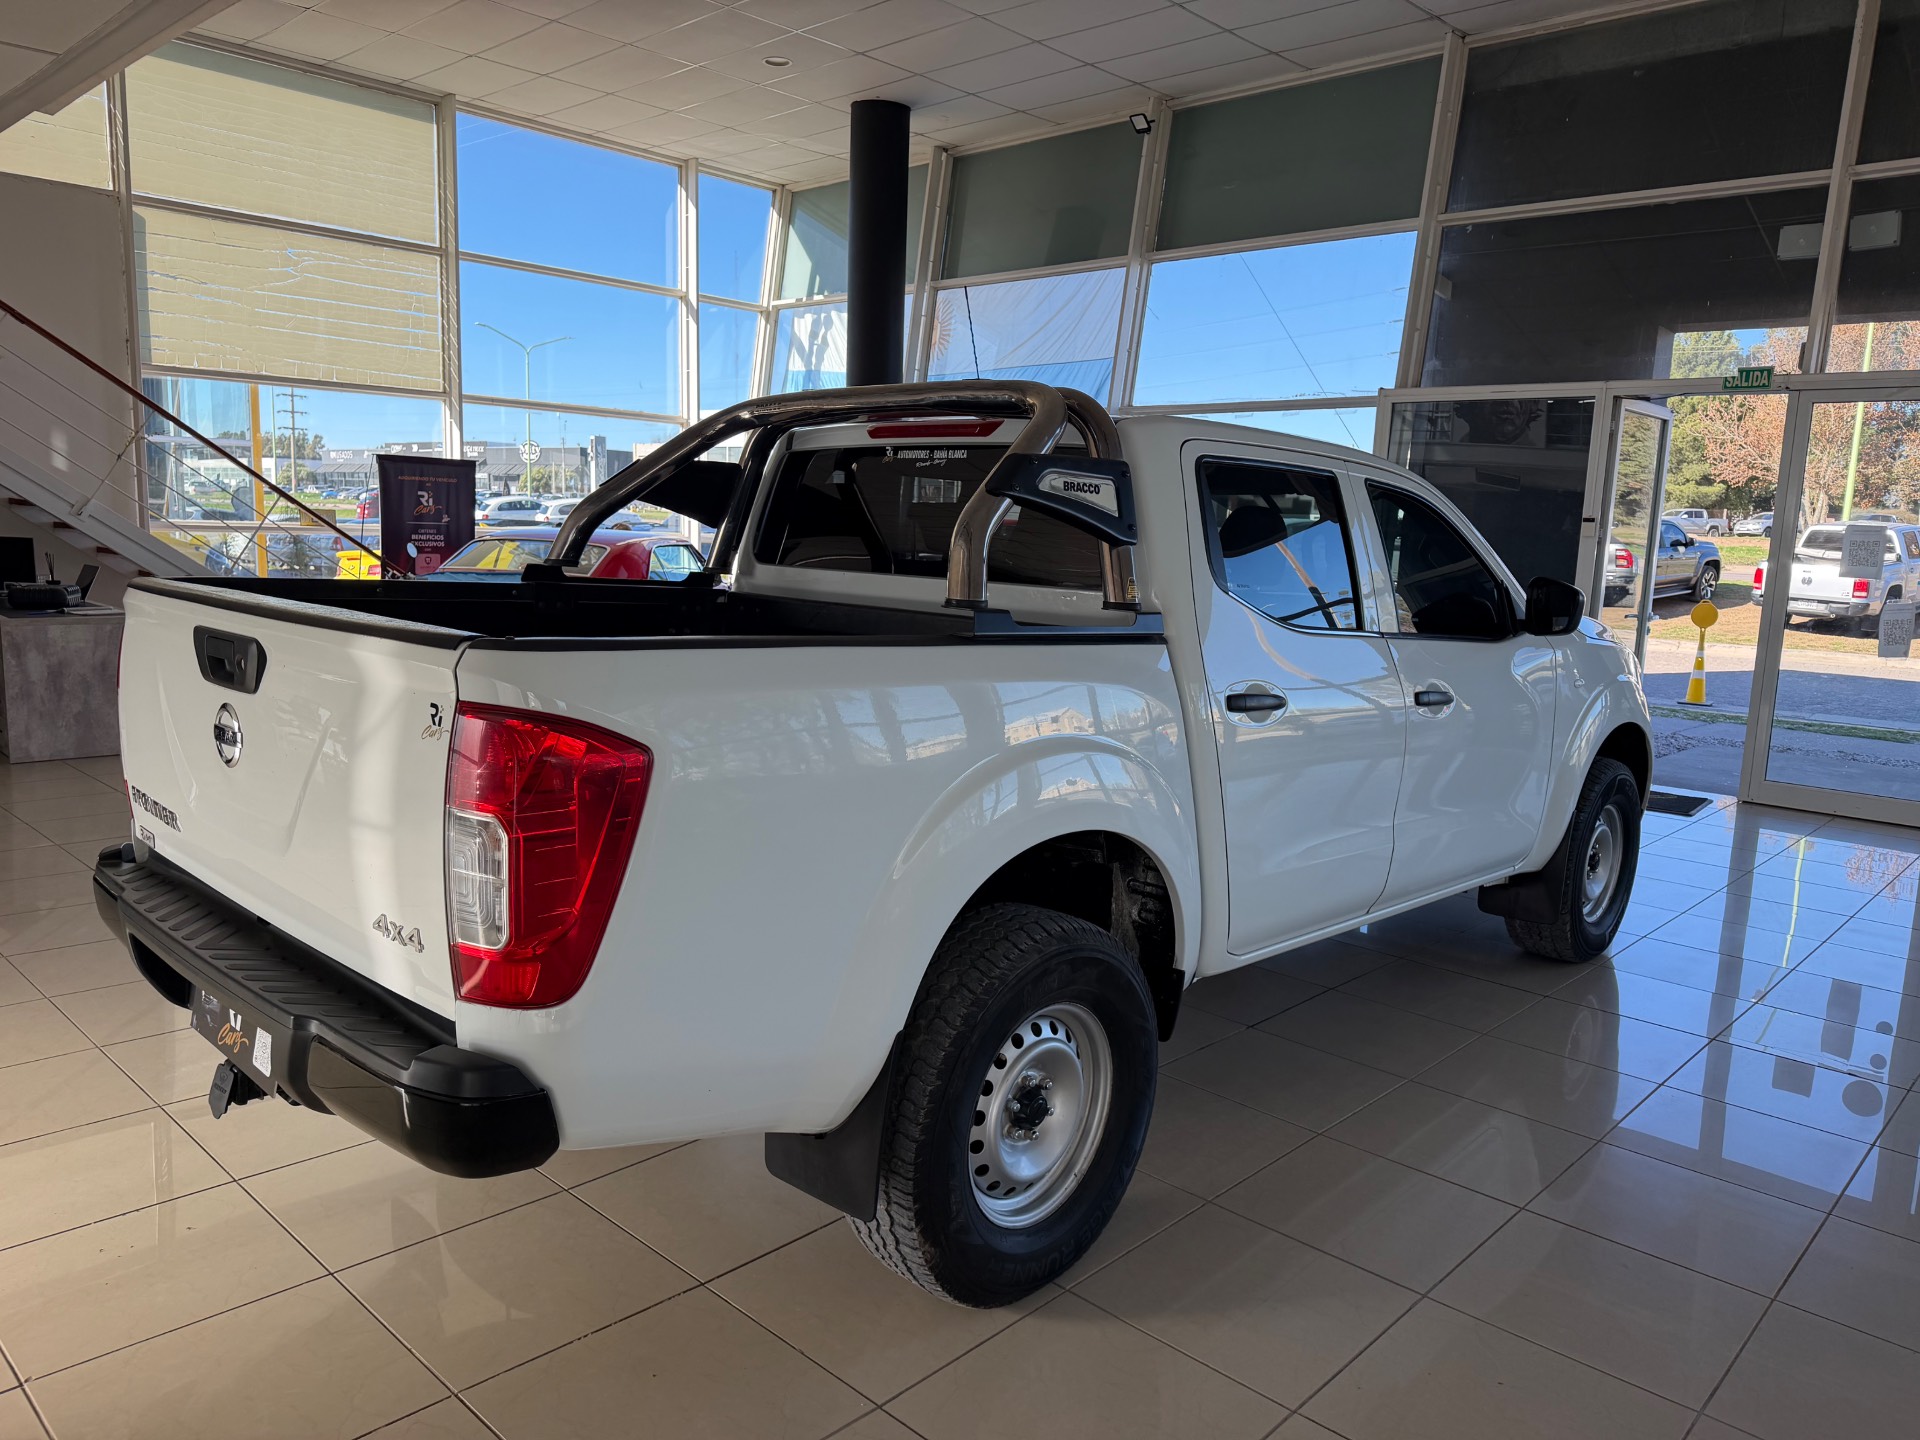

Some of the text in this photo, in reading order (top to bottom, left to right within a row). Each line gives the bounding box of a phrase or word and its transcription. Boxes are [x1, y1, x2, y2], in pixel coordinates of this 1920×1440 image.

[1725, 370, 1769, 388] SALIDA
[897, 450, 930, 459] AUTOMOTORES
[948, 449, 968, 459] BLANCA
[1063, 480, 1100, 495] BRACCO
